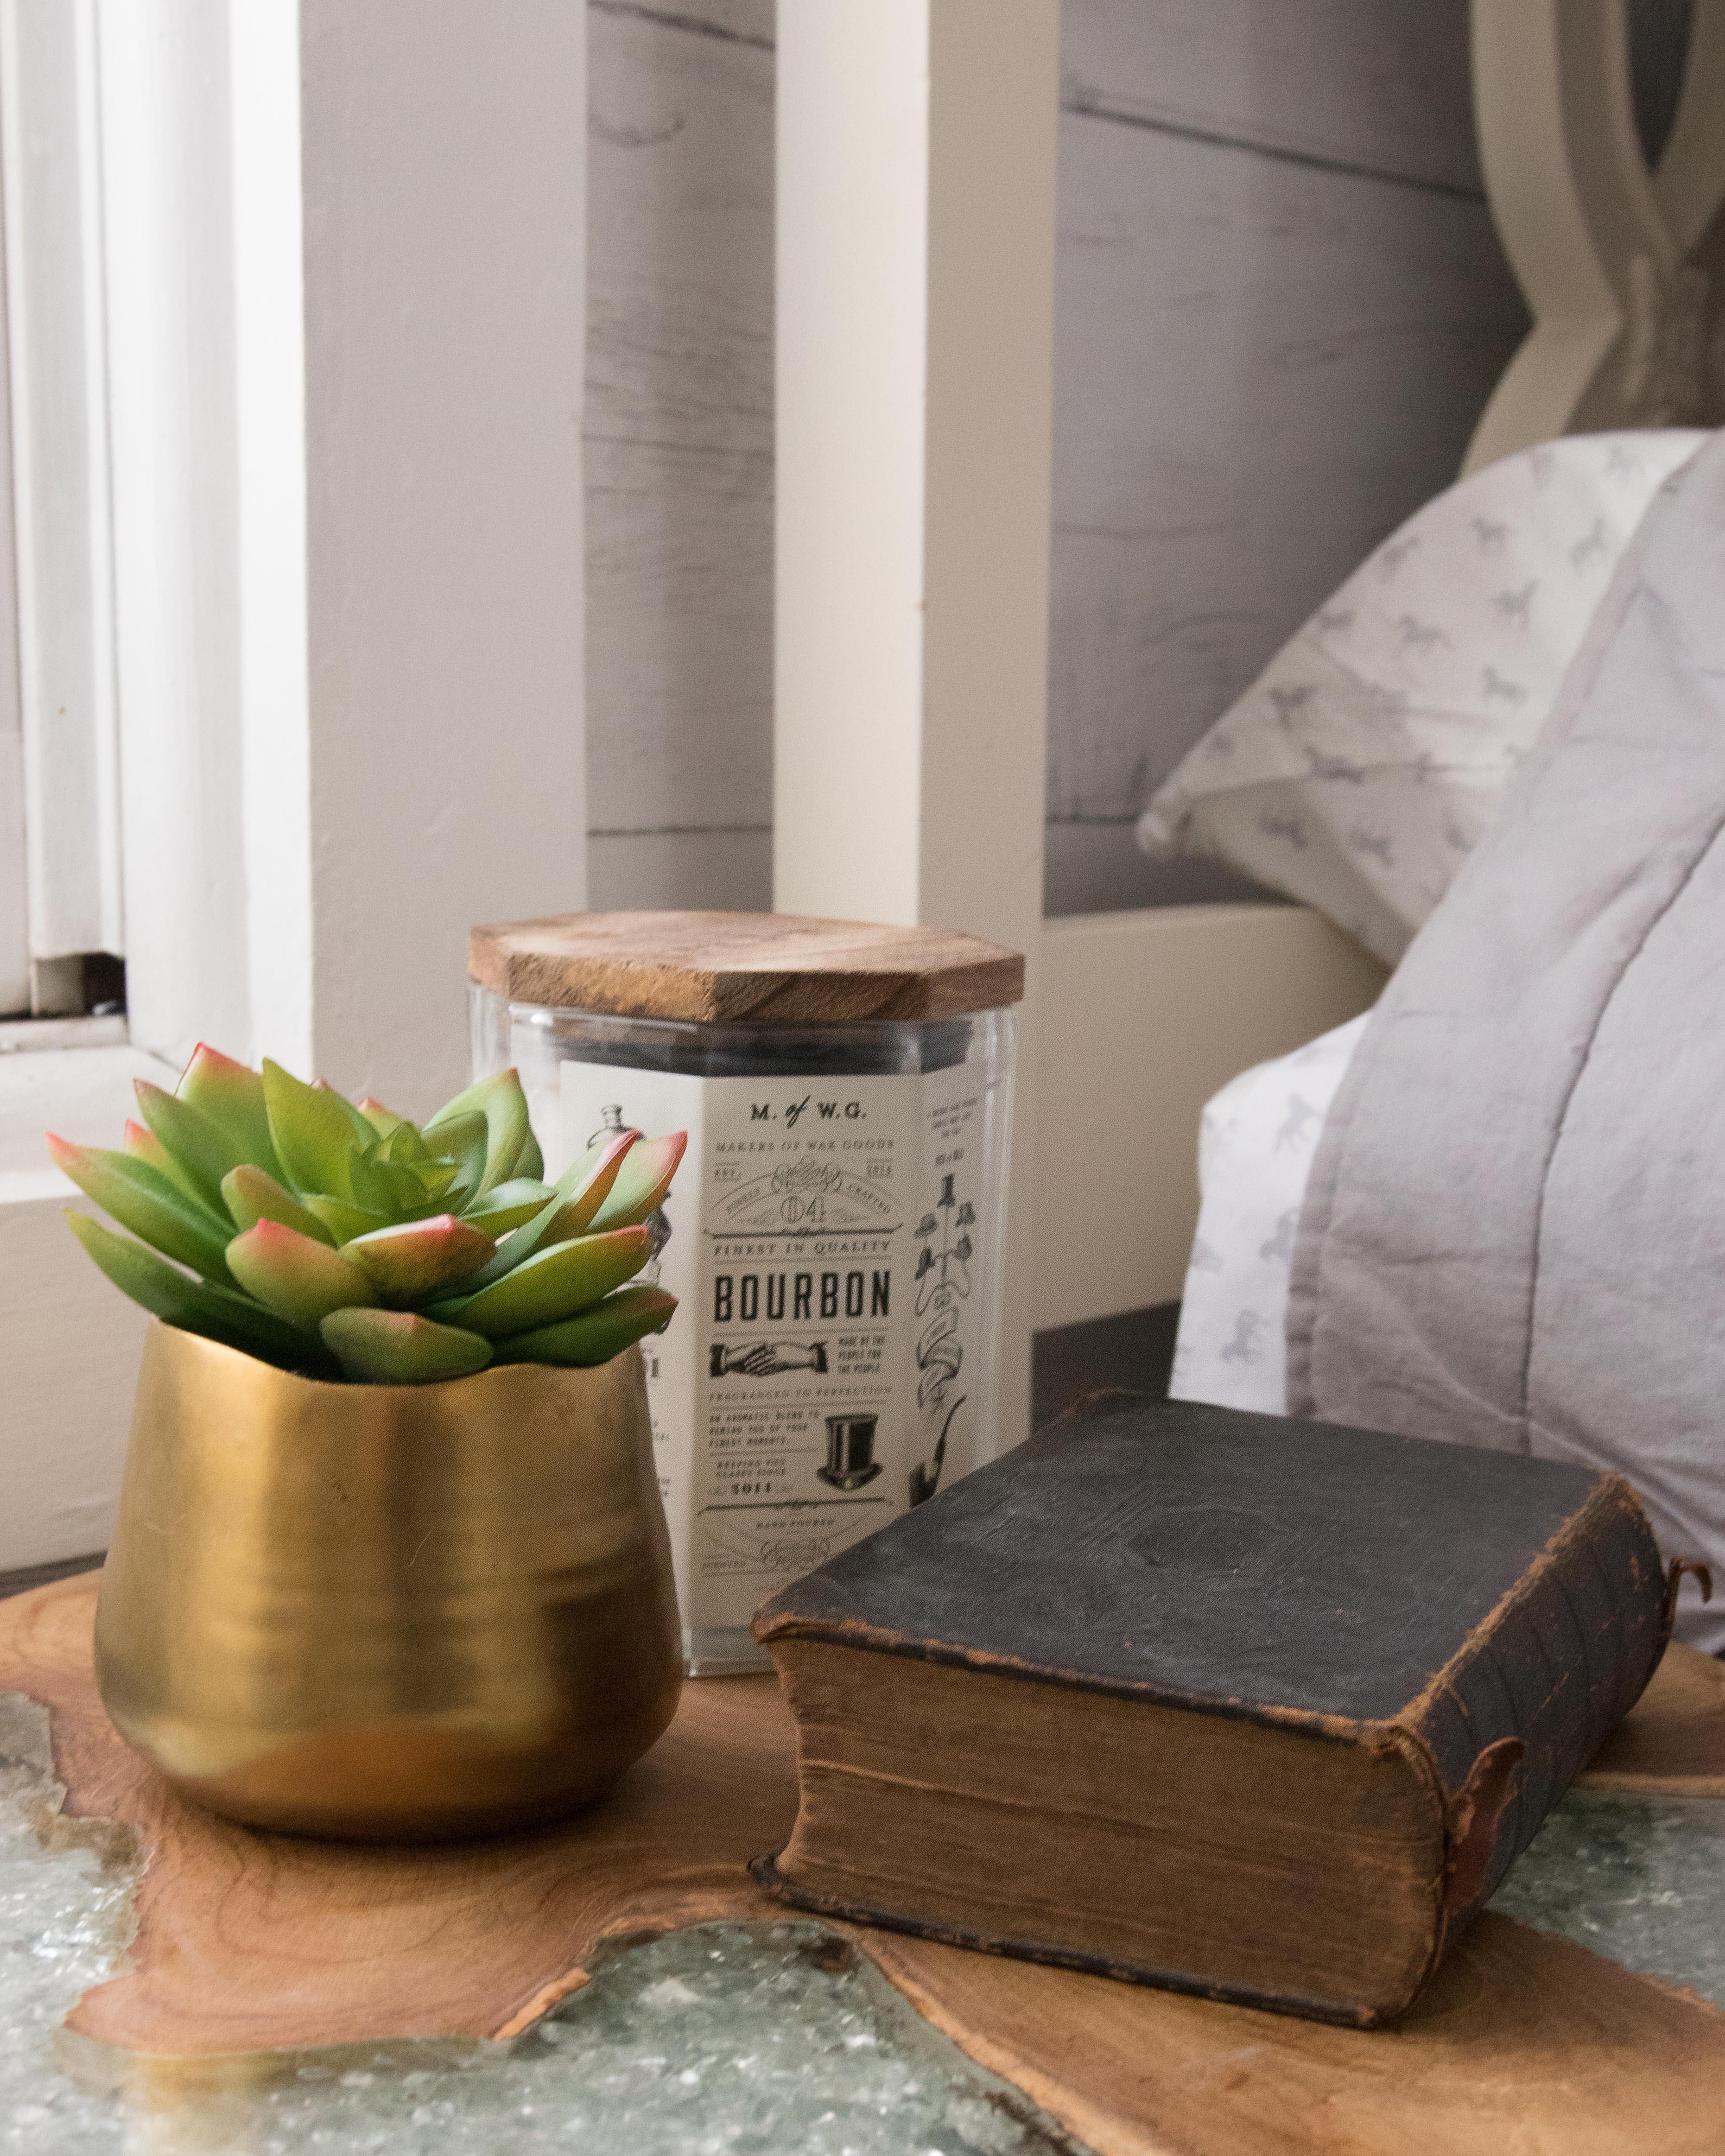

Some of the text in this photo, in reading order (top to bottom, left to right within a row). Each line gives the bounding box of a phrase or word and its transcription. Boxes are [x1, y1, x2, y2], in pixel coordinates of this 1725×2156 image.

[750, 1094, 867, 1130] M. of W.G.
[715, 1138, 894, 1153] MAKERS OF WAX GOODS
[713, 1240, 891, 1256] FINEST IN QUALITY
[714, 1270, 890, 1322] BOURBON
[838, 1350, 864, 1360] PEOPLE
[854, 1363, 880, 1374] PEOPLE
[709, 1385, 893, 1402] FRAGRANCED TO PERFECTION
[709, 1410, 820, 1423] AN AROMATIC BLEND TO
[748, 1424, 764, 1434] YOU
[769, 1424, 781, 1432] OF
[786, 1423, 809, 1432] YOUR
